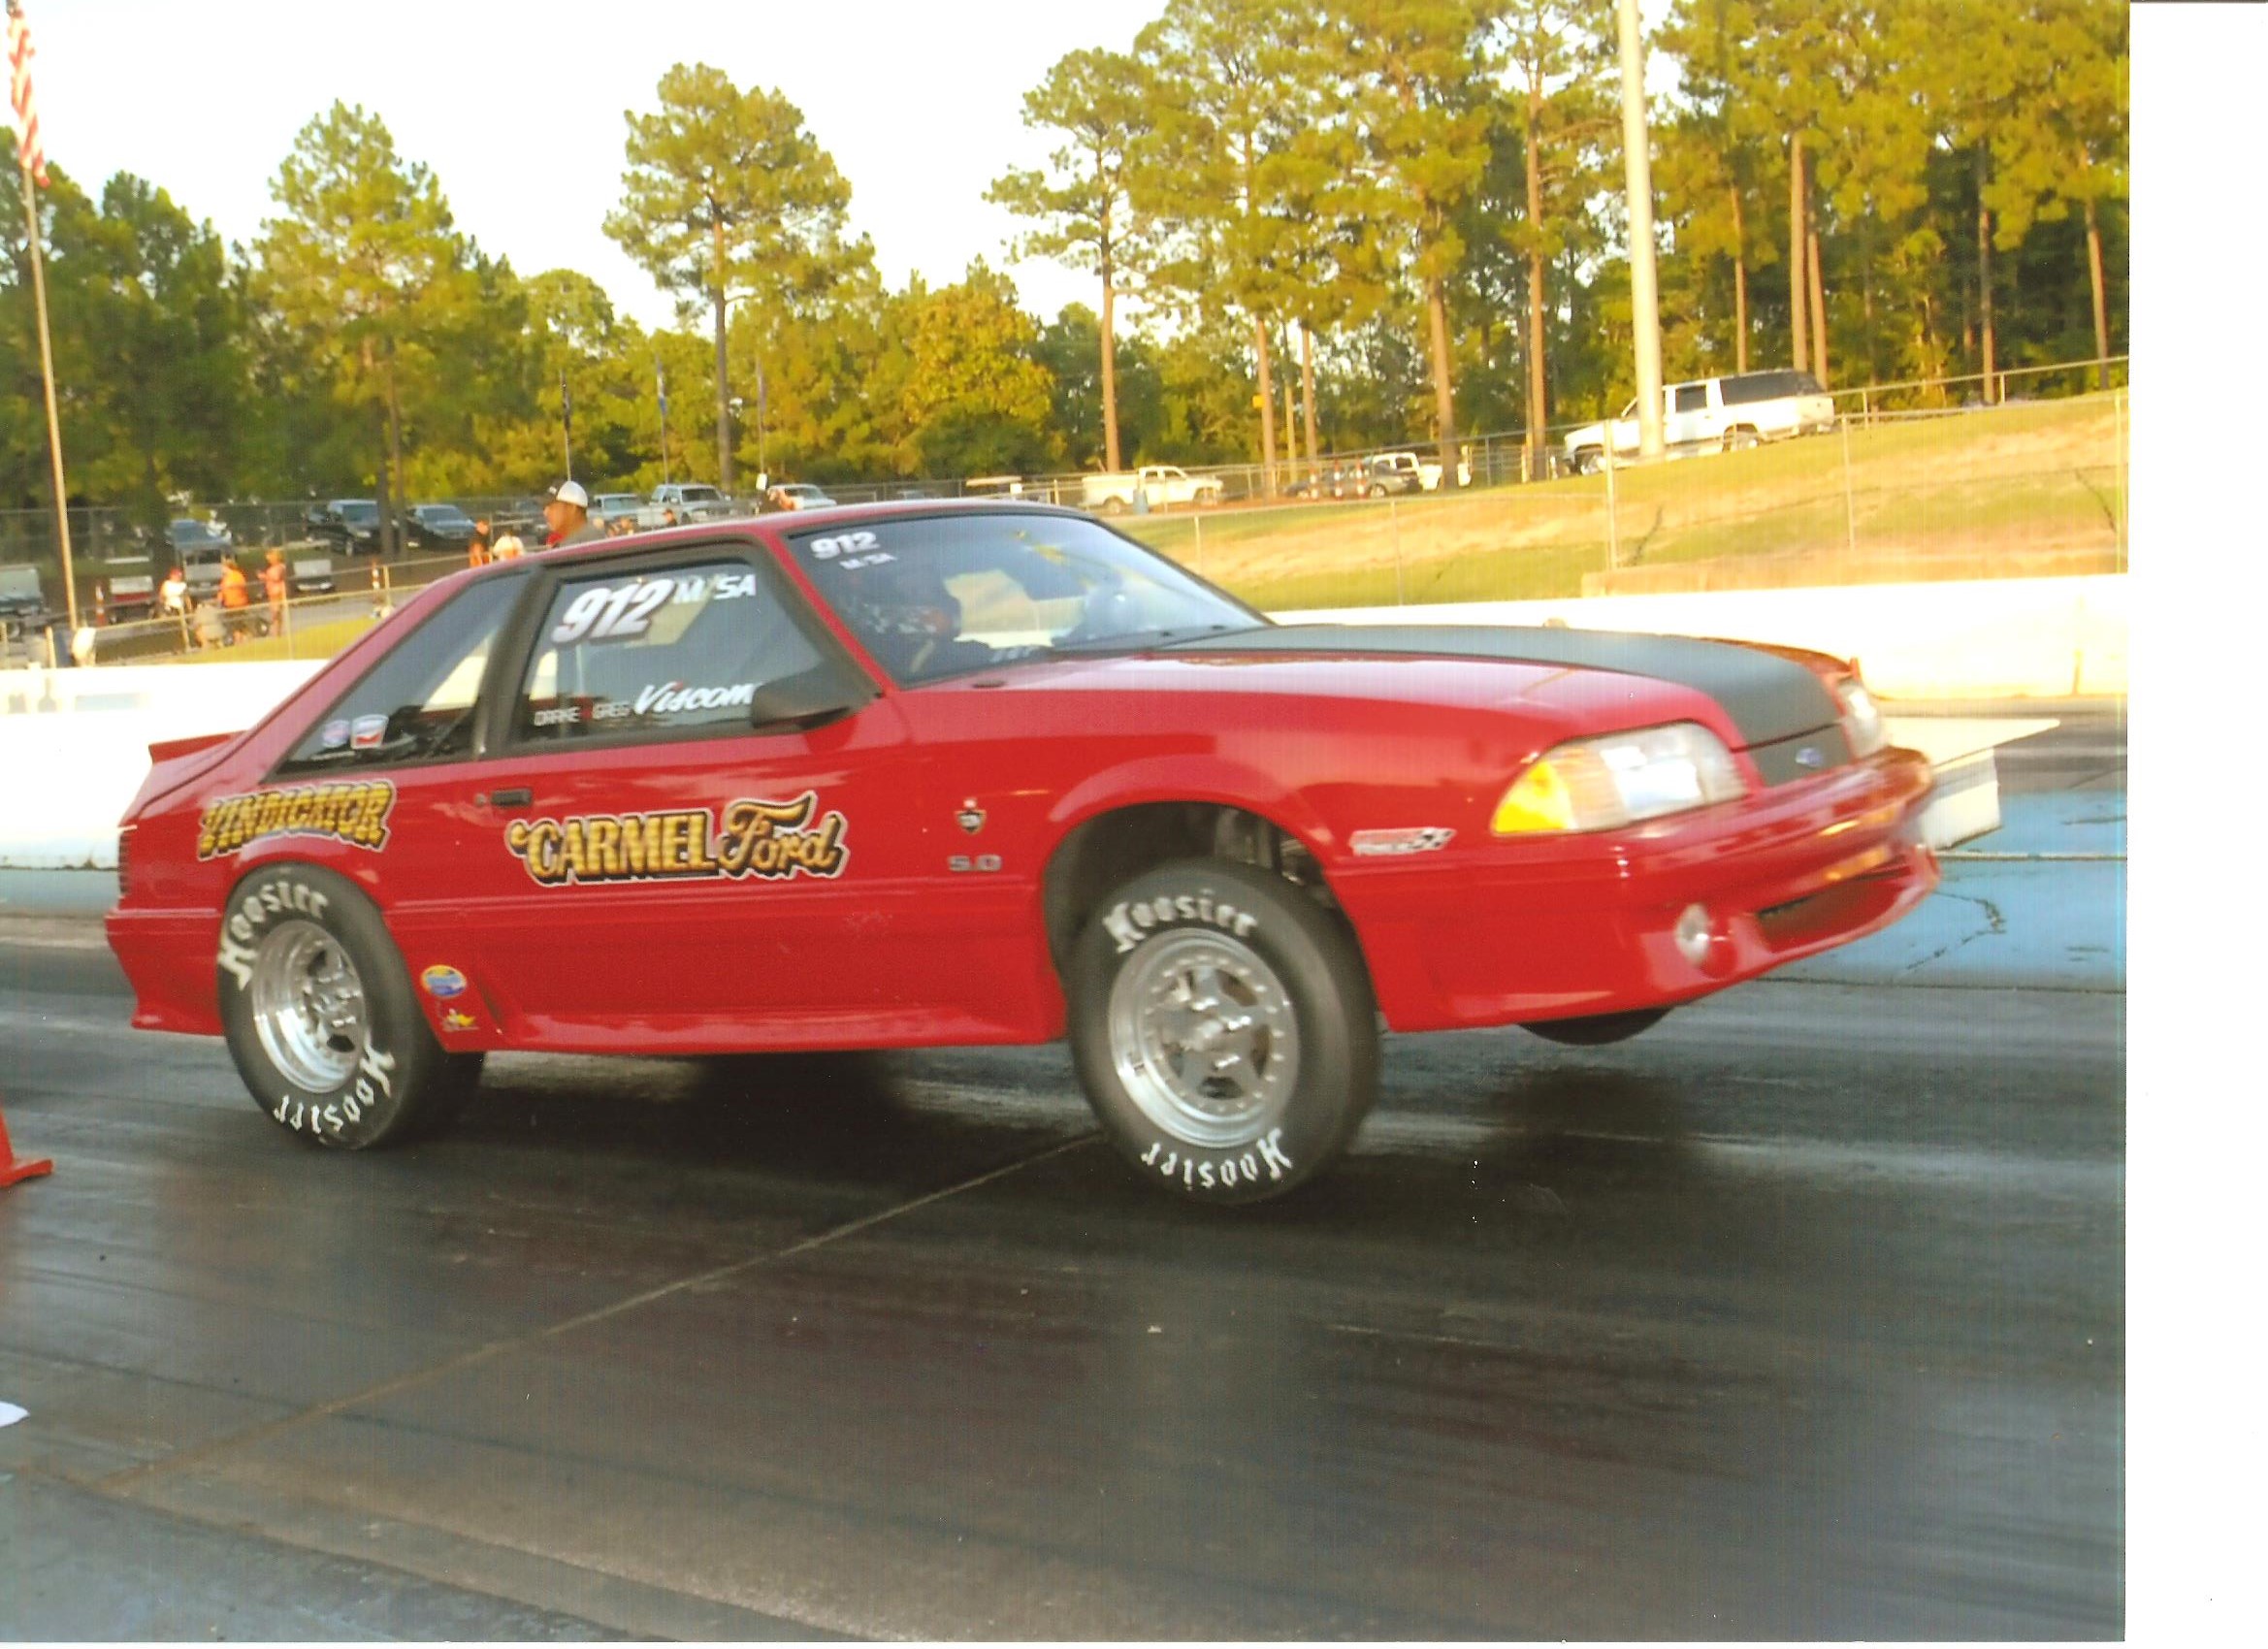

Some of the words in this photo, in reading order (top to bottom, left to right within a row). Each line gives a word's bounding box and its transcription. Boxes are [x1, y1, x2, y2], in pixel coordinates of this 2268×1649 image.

[809, 531, 881, 560] 912
[550, 579, 676, 644] 912
[509, 811, 720, 881] CARMEL
[718, 792, 844, 879] Ford
[1102, 889, 1257, 954] Hoosier
